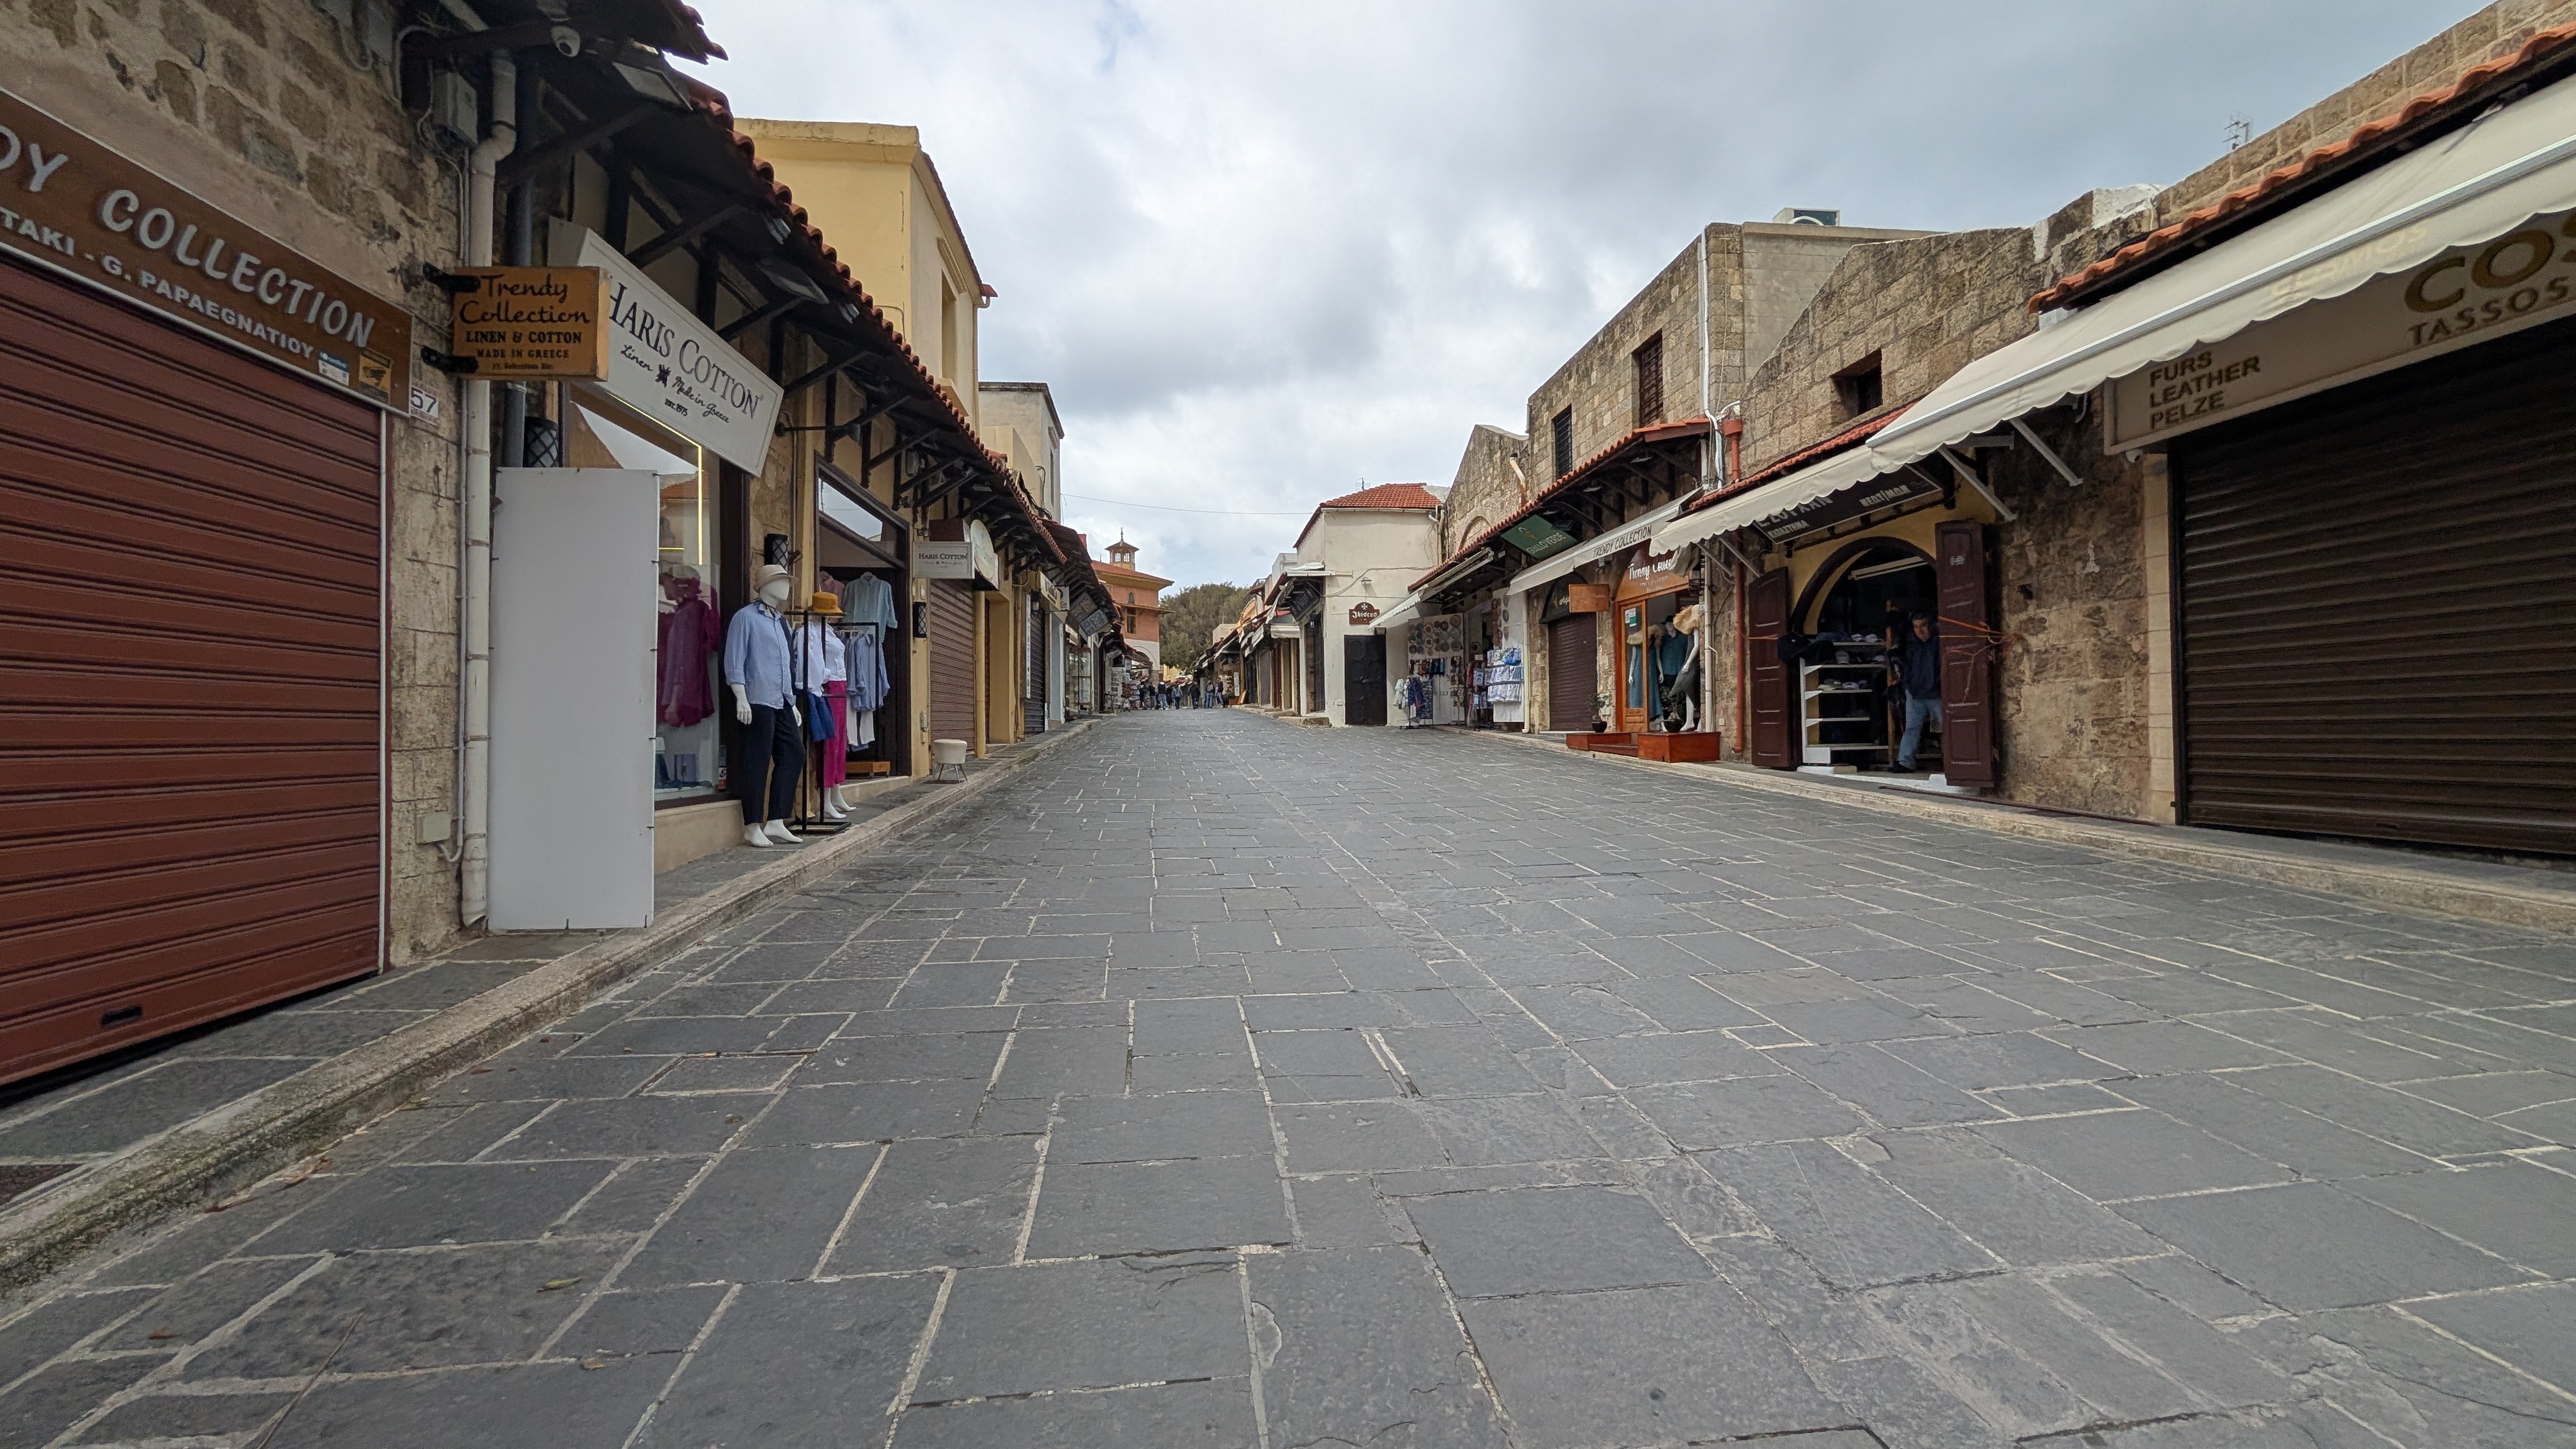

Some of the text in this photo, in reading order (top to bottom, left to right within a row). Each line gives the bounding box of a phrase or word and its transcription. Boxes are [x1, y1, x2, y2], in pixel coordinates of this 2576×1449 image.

[100, 189, 375, 348] COLLECTION
[2404, 211, 2576, 313] CO
[482, 273, 567, 303] Trendy
[137, 268, 314, 358] PAPAEGNATIOY
[460, 300, 590, 324] Collection
[2408, 275, 2568, 346] TASSOS
[466, 331, 582, 344] LINEN & COTTON
[477, 349, 569, 358] MADE IN GREECE
[609, 282, 760, 419] HARIS COTTON
[620, 344, 653, 371] Linen
[672, 376, 694, 400] Made
[703, 403, 730, 424] Greece
[2150, 351, 2212, 387] FURS
[2150, 356, 2261, 408] LEATHER
[411, 387, 438, 413] 57
[2149, 390, 2225, 430] PELZE
[1593, 524, 1652, 559] TRENDY COLLECTION
